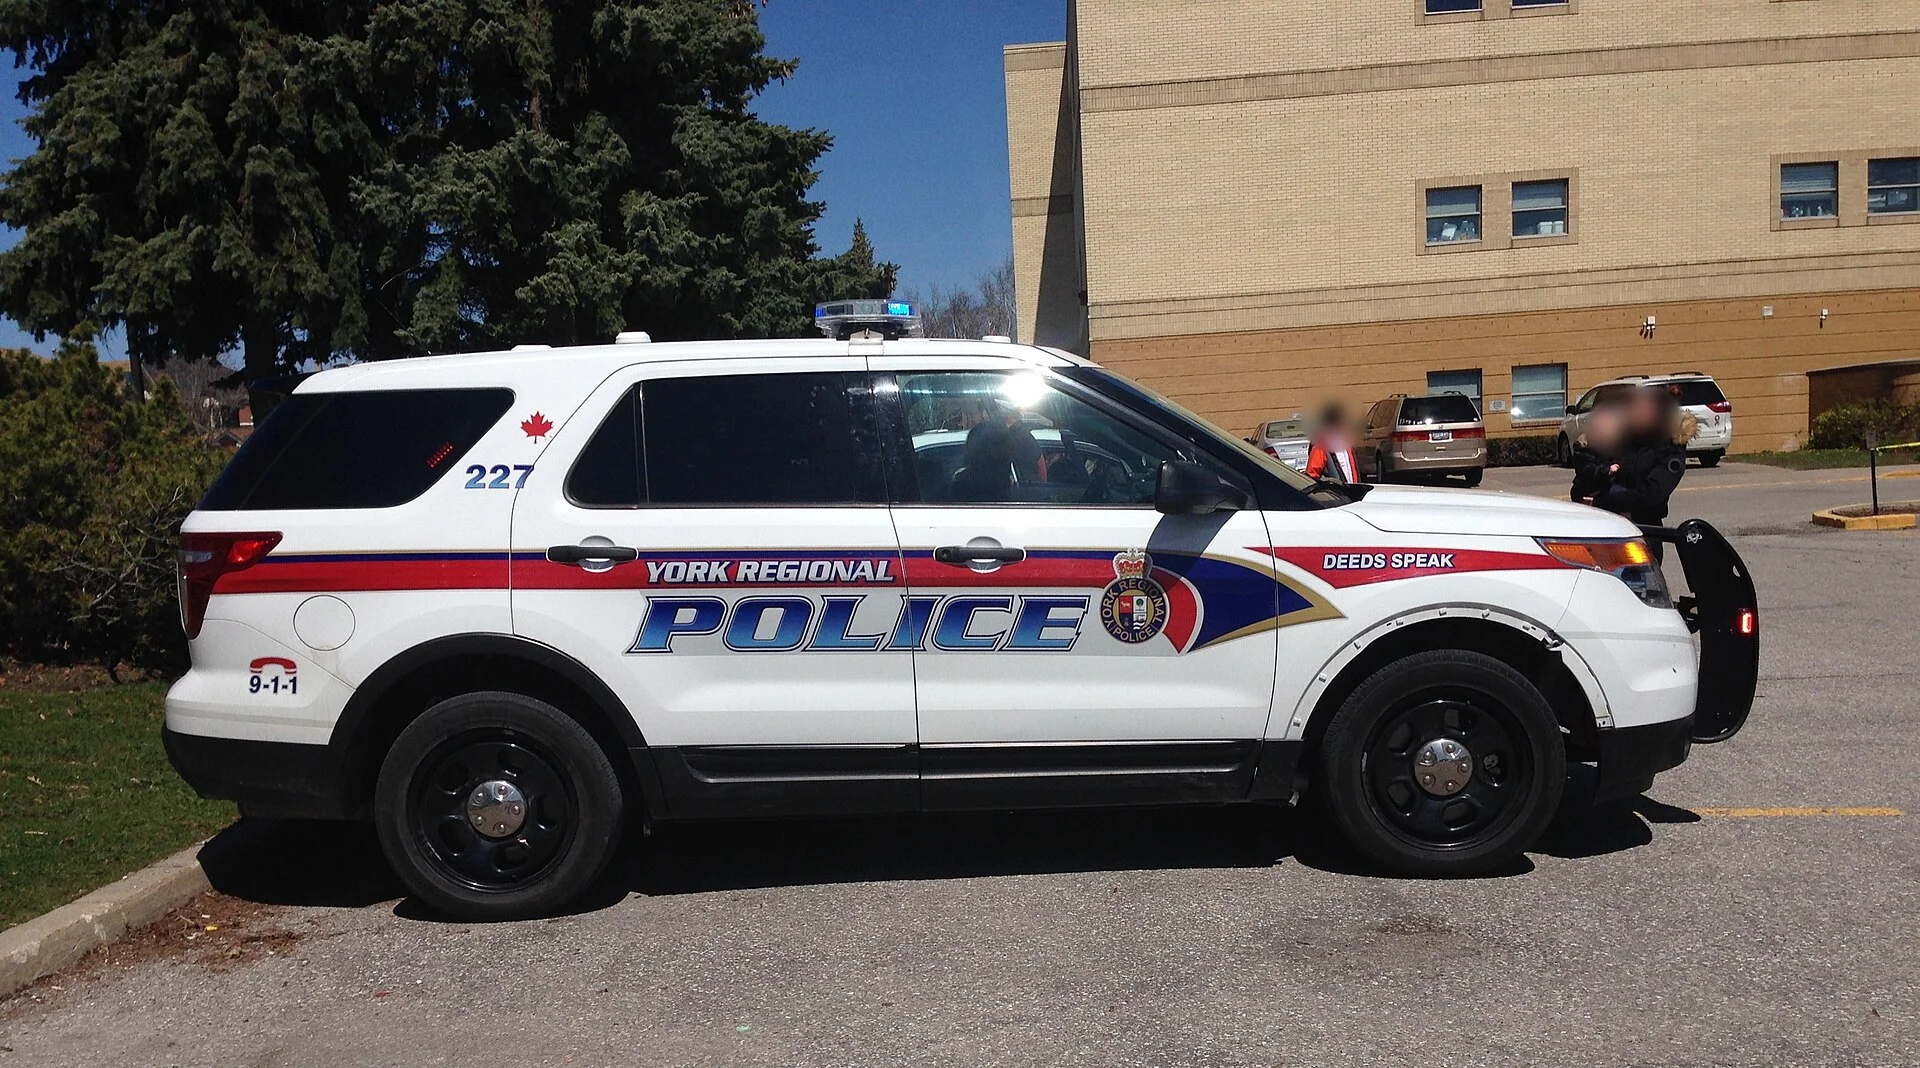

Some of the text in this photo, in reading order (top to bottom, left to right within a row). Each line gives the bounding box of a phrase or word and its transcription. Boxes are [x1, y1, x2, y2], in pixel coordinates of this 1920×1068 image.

[465, 464, 535, 489] 227
[645, 559, 896, 584] YORK REGIONAL
[1322, 552, 1455, 570] DEEDS SPEAK
[1102, 579, 1165, 628] YORK REGIONAL
[624, 594, 1092, 654] POLICE
[1113, 627, 1155, 642] POLICE
[248, 674, 298, 695] 9-1-1
